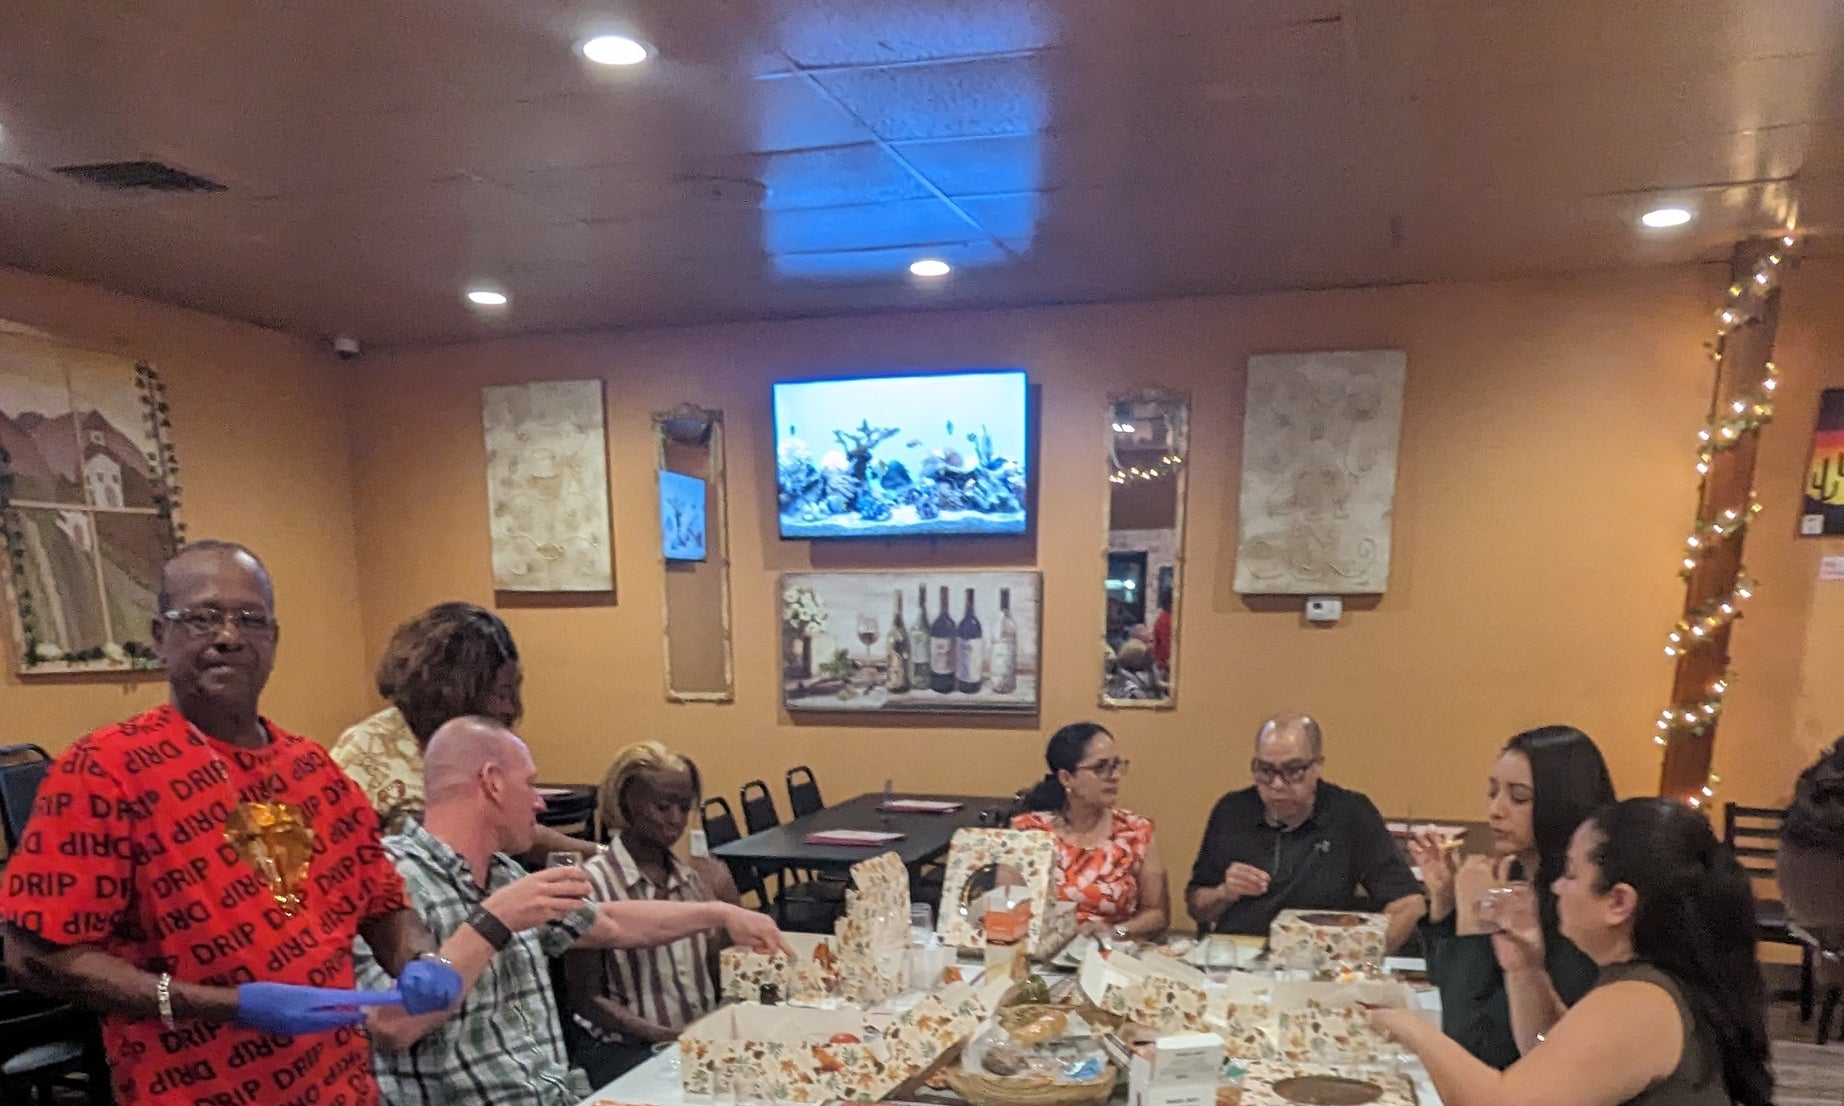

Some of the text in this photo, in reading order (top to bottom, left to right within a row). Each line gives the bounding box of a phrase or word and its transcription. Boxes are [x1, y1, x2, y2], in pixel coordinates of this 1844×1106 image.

[125, 740, 182, 775] DRIP
[169, 759, 228, 800] DRIP
[172, 800, 229, 844] DRIP
[59, 830, 132, 860] DRIP
[9, 872, 77, 897] DRIP
[152, 857, 208, 899] DRIP
[191, 921, 254, 965] DRIP
[267, 928, 318, 972] DRIP
[149, 1059, 217, 1095] DRIP
